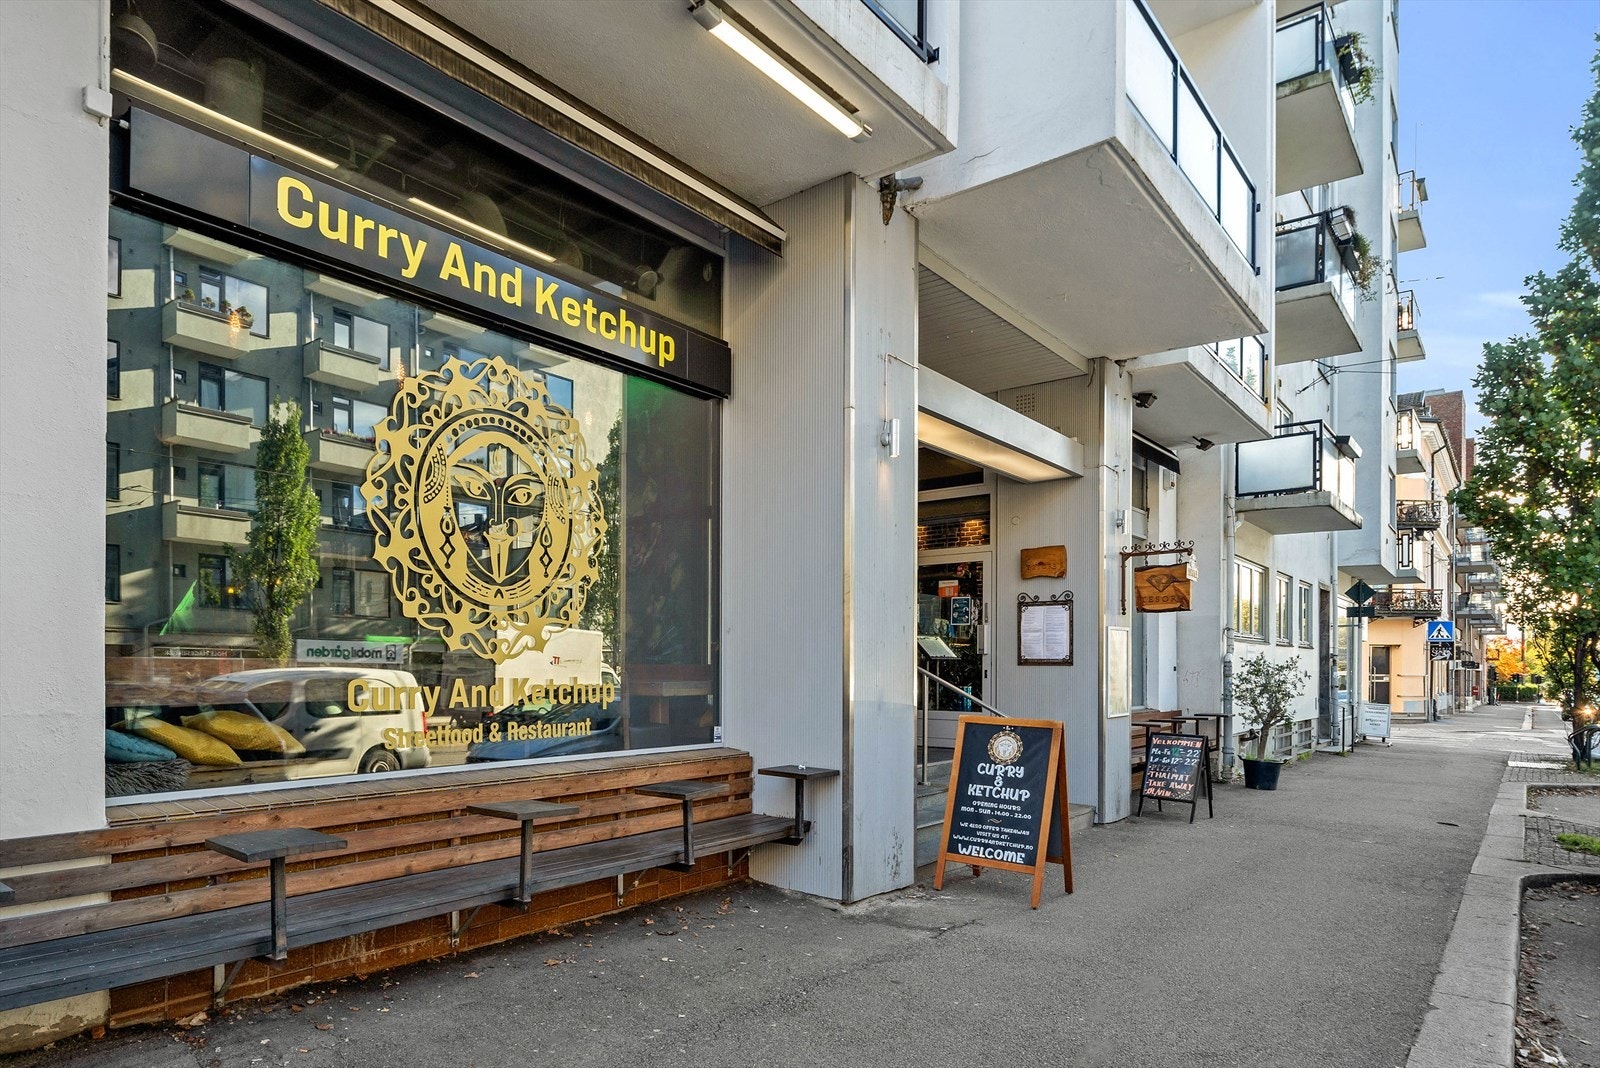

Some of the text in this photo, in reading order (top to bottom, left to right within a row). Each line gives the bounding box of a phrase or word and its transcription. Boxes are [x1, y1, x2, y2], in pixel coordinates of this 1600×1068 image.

[277, 176, 676, 367] Curry And Ketchup
[347, 676, 615, 717] Curry And Ketchup
[383, 717, 592, 751] Streetfood & Restaurant
[977, 763, 1025, 778] CURRY
[994, 775, 1004, 787] &
[1169, 781, 1194, 791] AWAY
[968, 784, 1031, 801] KETCHUP
[972, 800, 998, 808] OPENING
[1000, 827, 1030, 836] TAKEAWAY
[957, 843, 1026, 864] WELCOME
